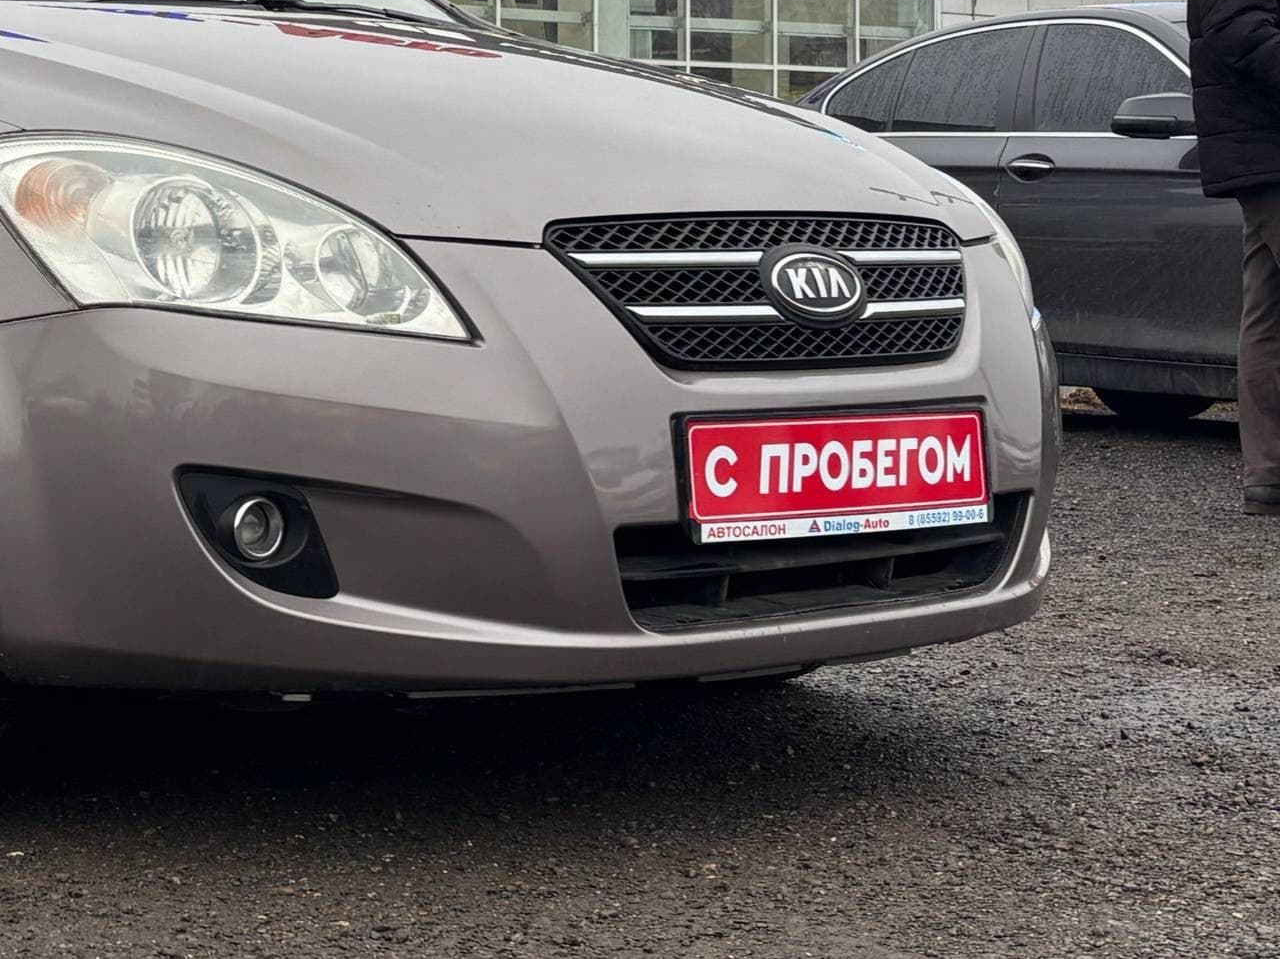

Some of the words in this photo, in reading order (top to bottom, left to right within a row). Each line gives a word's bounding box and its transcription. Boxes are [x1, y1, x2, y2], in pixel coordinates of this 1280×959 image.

[784, 267, 851, 299] KIA
[704, 445, 738, 498] С
[759, 434, 971, 495] ПРОБЕГОМ
[823, 518, 890, 534] Dialog-Auto
[908, 514, 915, 526] 8
[706, 523, 787, 540] АВТОСАЛОН
